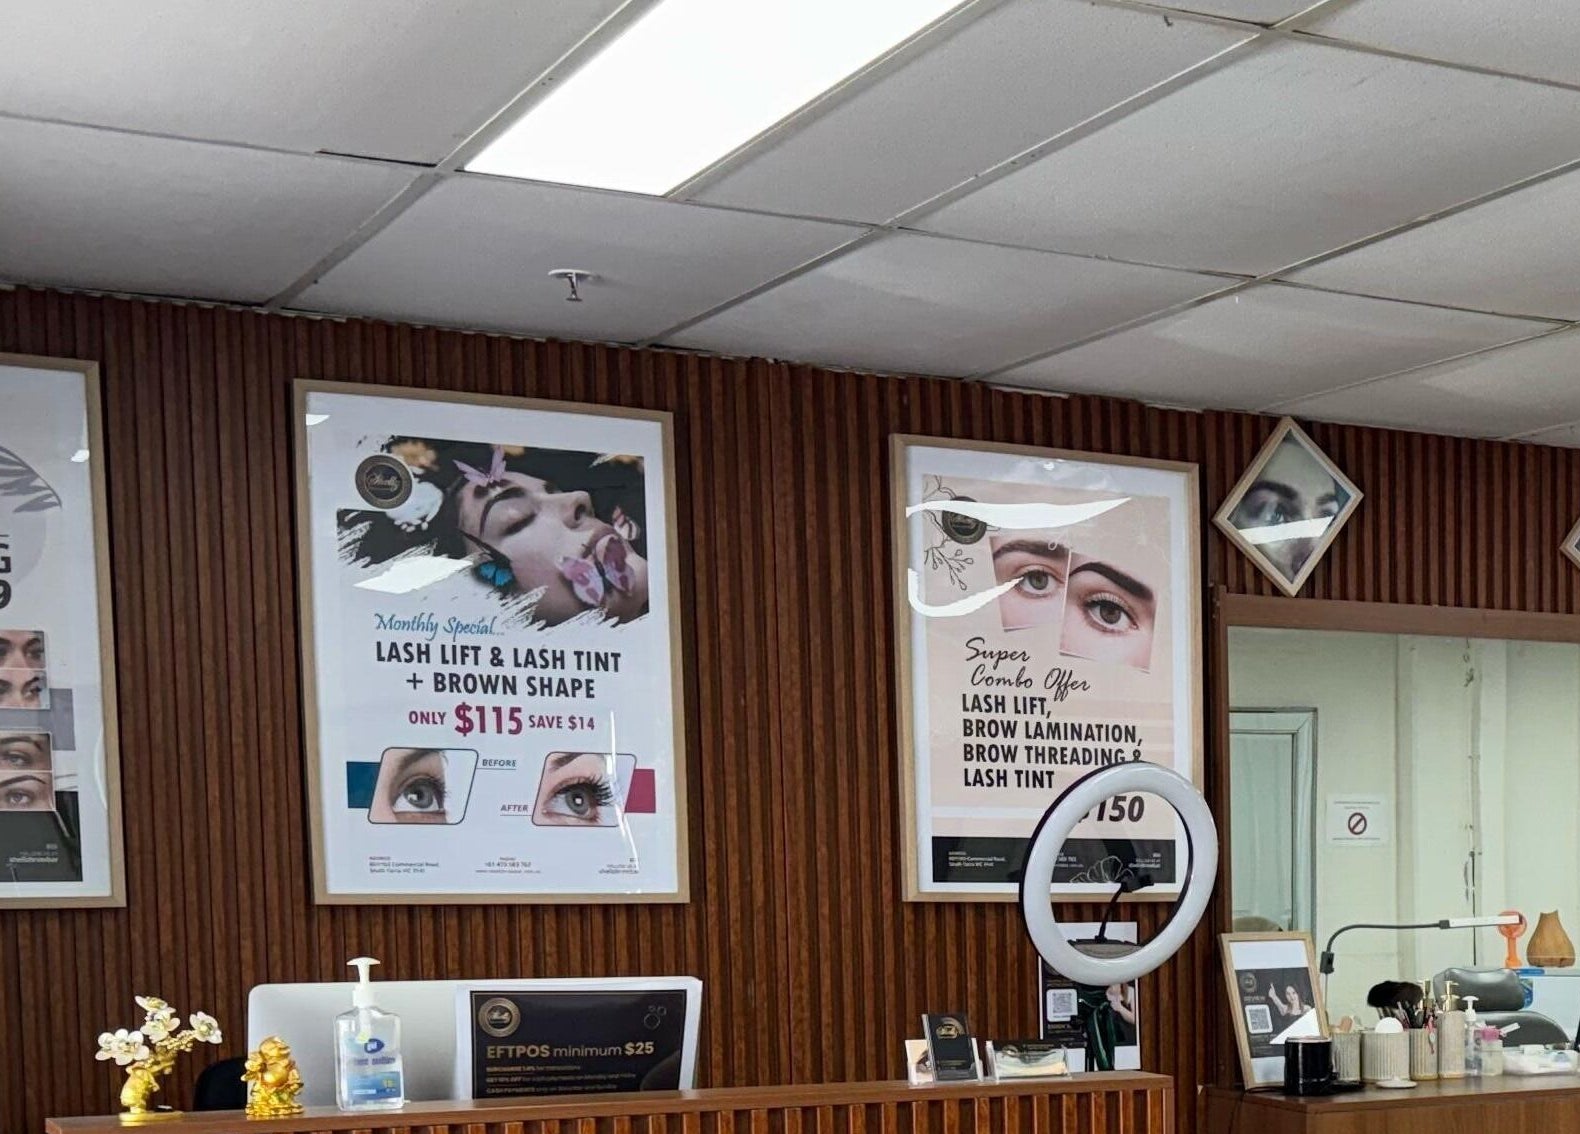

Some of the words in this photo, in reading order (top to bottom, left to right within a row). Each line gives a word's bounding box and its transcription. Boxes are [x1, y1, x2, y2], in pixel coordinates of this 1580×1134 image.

[374, 613, 439, 641] Monthly
[376, 641, 430, 663] LASH
[441, 644, 481, 666] LIFT
[490, 647, 504, 667] &
[513, 648, 565, 670] LASH
[574, 651, 621, 672] TINT
[965, 637, 1030, 670] Super
[406, 673, 423, 690] +
[434, 672, 517, 695] BROWN
[527, 676, 595, 698] SHAPE
[971, 664, 1033, 688] Combo
[1044, 668, 1090, 702] Offer
[408, 710, 447, 725] ONLY
[454, 702, 523, 737] $115
[529, 715, 563, 729] SAVE
[568, 715, 595, 731] $14
[962, 694, 1006, 713] LASH
[1014, 696, 1051, 719] LIFT,
[963, 718, 1018, 738] BROW
[1025, 721, 1143, 746] LAMINATION,
[482, 759, 516, 767] BEFORE
[963, 744, 1018, 763] BROW
[1025, 745, 1125, 766] THREADING
[964, 768, 1007, 787] LASH
[1015, 769, 1055, 788] TINT
[501, 804, 528, 812] AFTER
[1078, 795, 1145, 824] 150
[487, 1045, 549, 1059] EFTPOS
[553, 1043, 622, 1058] minimum
[625, 1041, 654, 1055] $25
